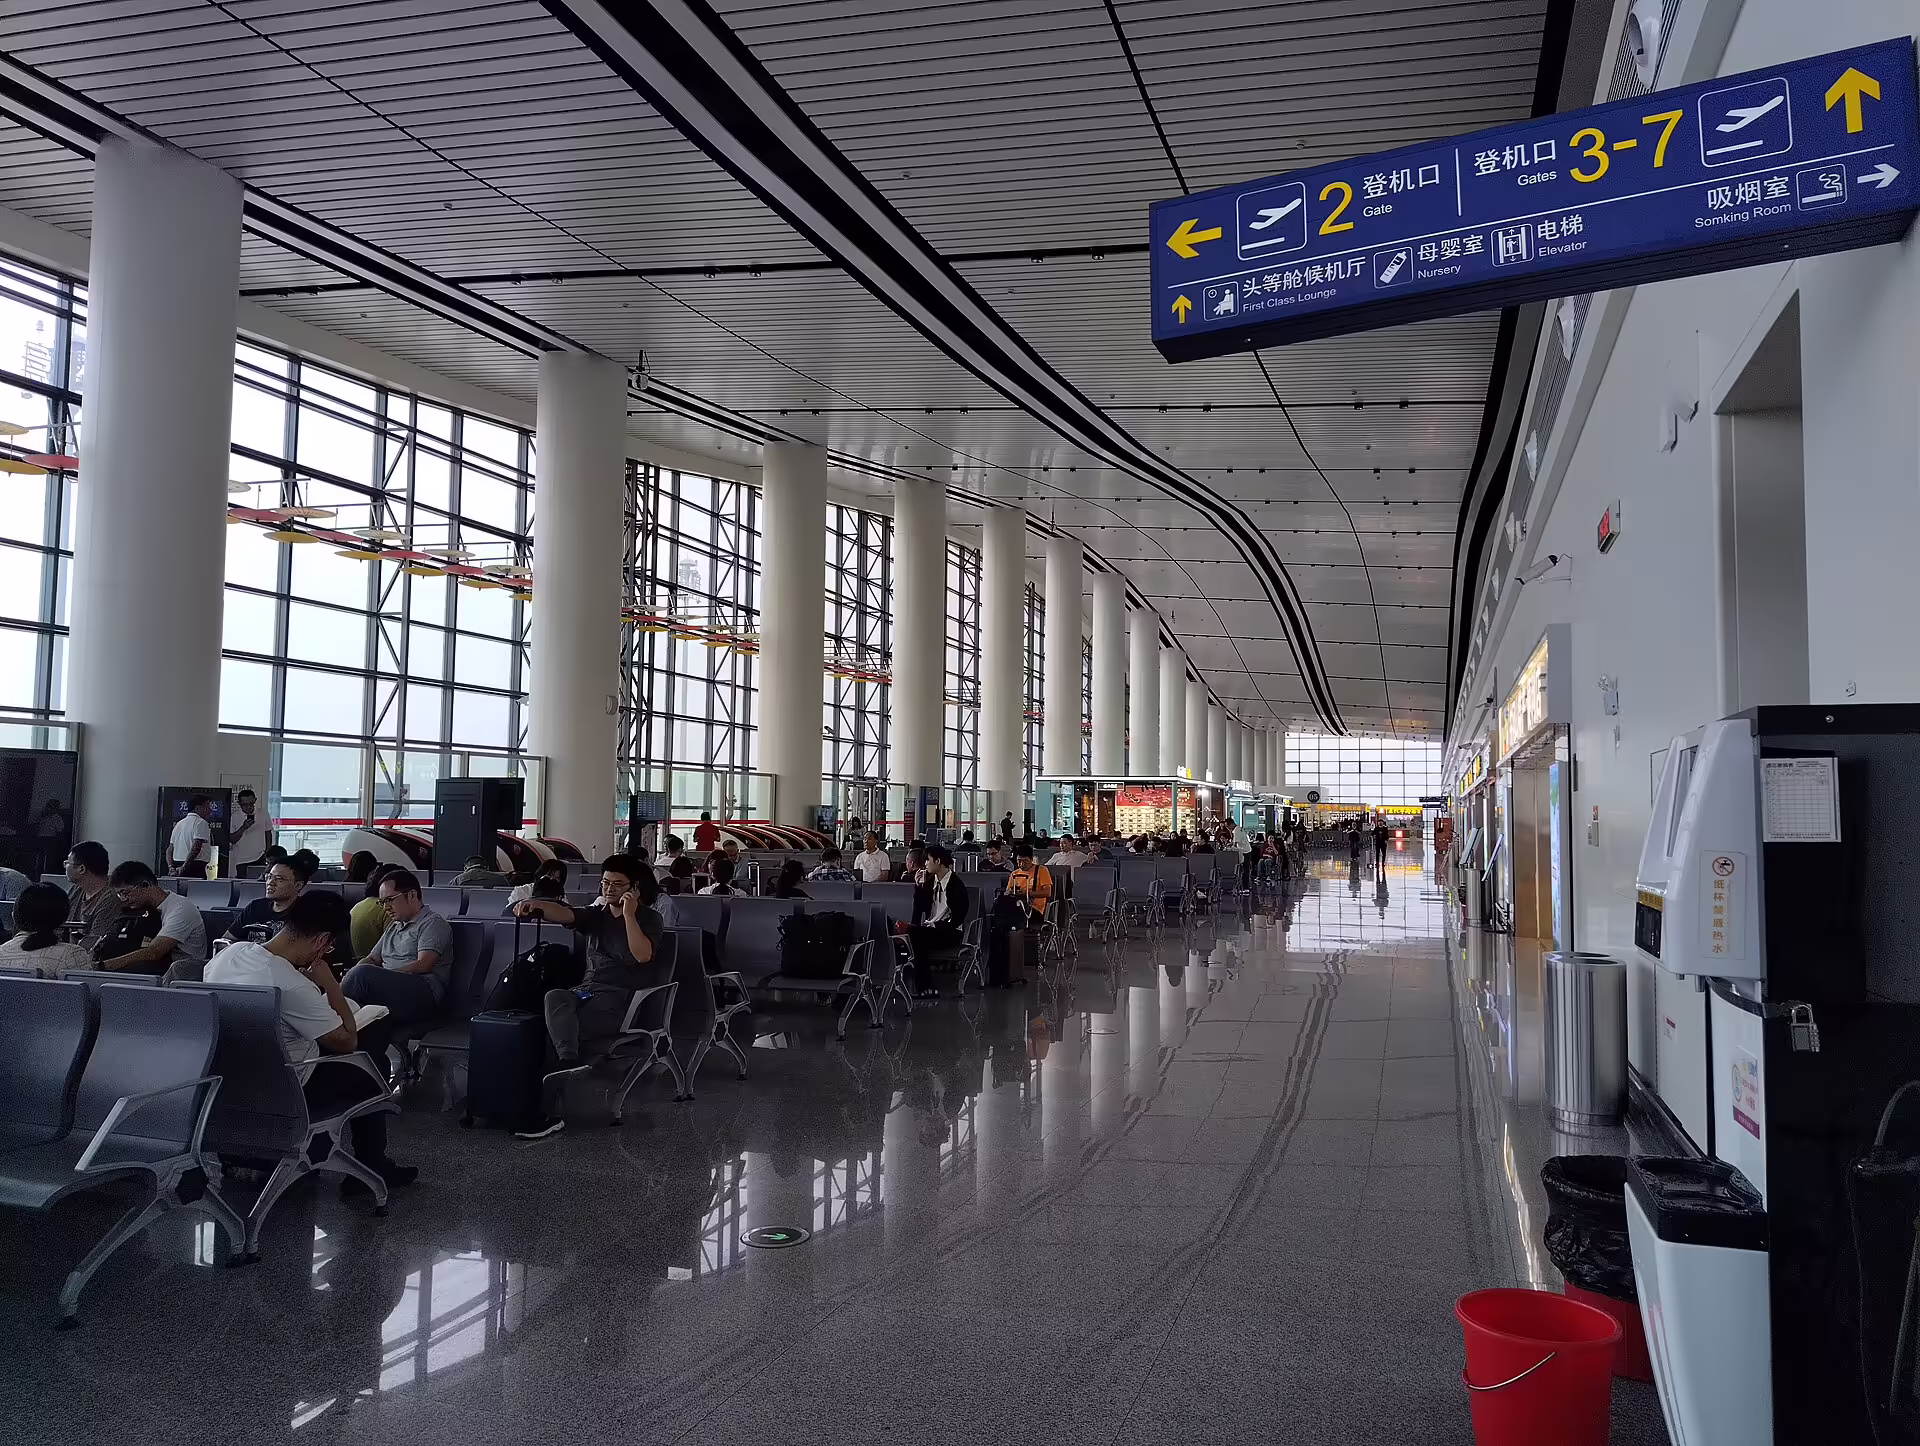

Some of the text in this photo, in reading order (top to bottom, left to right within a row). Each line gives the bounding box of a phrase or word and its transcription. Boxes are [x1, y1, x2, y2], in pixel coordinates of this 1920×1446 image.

[1473, 138, 1558, 177] 登机口
[1568, 109, 1684, 183] 3-7
[1362, 163, 1441, 201] 登机口
[1517, 168, 1558, 187] Gates
[1707, 175, 1791, 210] 吸烟室
[1318, 181, 1355, 236] 2
[1362, 202, 1393, 218] Gate
[1694, 200, 1793, 230] Somking Room
[1537, 213, 1584, 241] 电梯
[1417, 233, 1485, 264] 母婴室
[1538, 239, 1588, 258] Elevator
[1242, 256, 1366, 298] 头等舱候机厅
[1417, 262, 1462, 280] Nursery
[1242, 286, 1338, 314] First Class Lounge
[1308, 792, 1319, 801] 05
